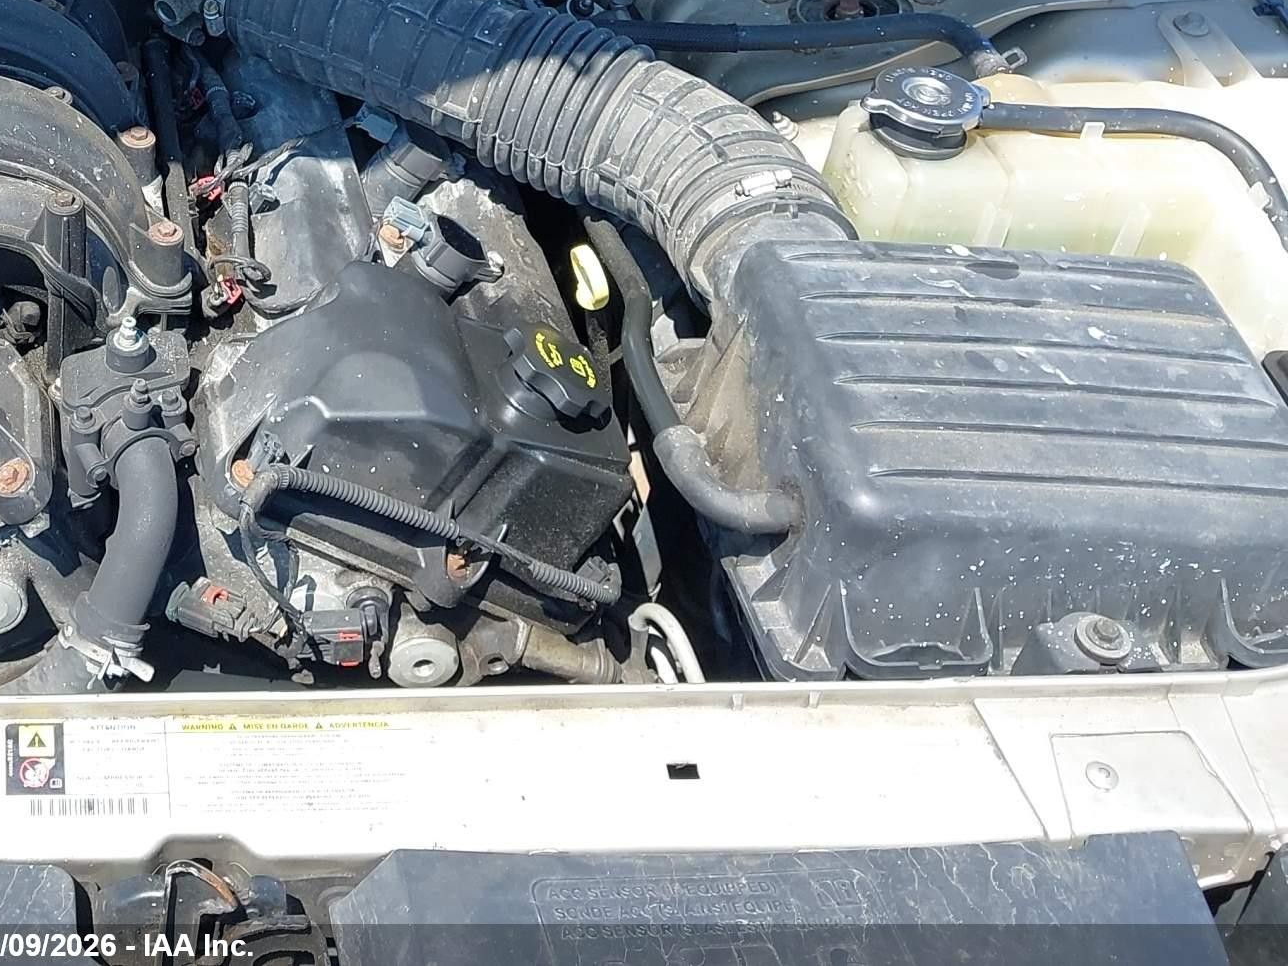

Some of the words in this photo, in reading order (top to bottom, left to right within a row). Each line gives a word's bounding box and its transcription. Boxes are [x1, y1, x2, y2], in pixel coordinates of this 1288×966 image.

[181, 722, 224, 731] WARNING
[243, 722, 264, 730] MISE
[587, 884, 657, 901] SENSOR
[686, 880, 777, 898] EQUIPPED)
[553, 905, 614, 921] SONDE
